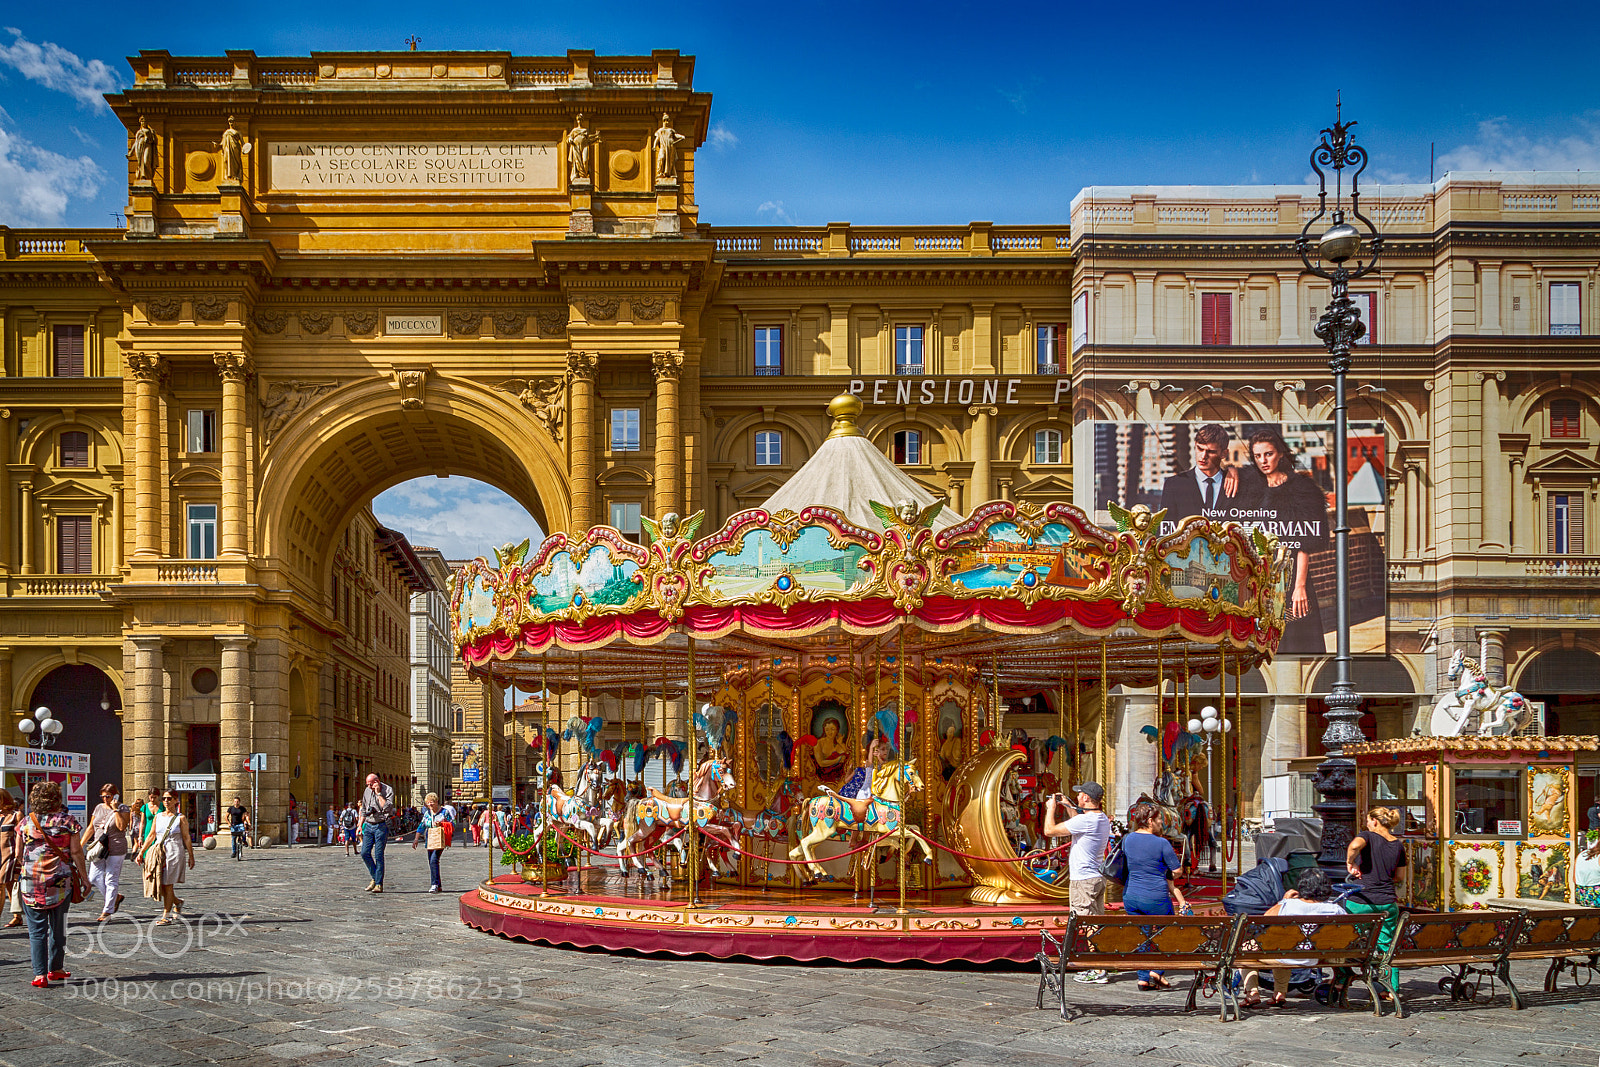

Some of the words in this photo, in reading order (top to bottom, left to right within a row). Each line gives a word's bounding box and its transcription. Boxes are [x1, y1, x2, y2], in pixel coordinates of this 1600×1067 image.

[295, 145, 355, 156] ANTICO
[362, 145, 429, 156] CENTRO
[436, 145, 491, 156] DELLA
[300, 159, 322, 170] DA
[329, 159, 417, 170] SECOLARE
[424, 159, 525, 170] SQUALLORE
[300, 173, 311, 184] A
[318, 173, 356, 184] VITA
[363, 173, 419, 184] NUOVA
[426, 173, 525, 184] RESTITUITO
[388, 320, 438, 330] MDCCCXCV
[850, 379, 1021, 404] PENSIONE
[1201, 508, 1226, 518] New
[1229, 508, 1277, 519] Opening
[1257, 520, 1321, 536] ARMANI
[25, 752, 46, 767] INFO
[48, 754, 72, 768] POINT
[177, 781, 207, 790] VOGUE
